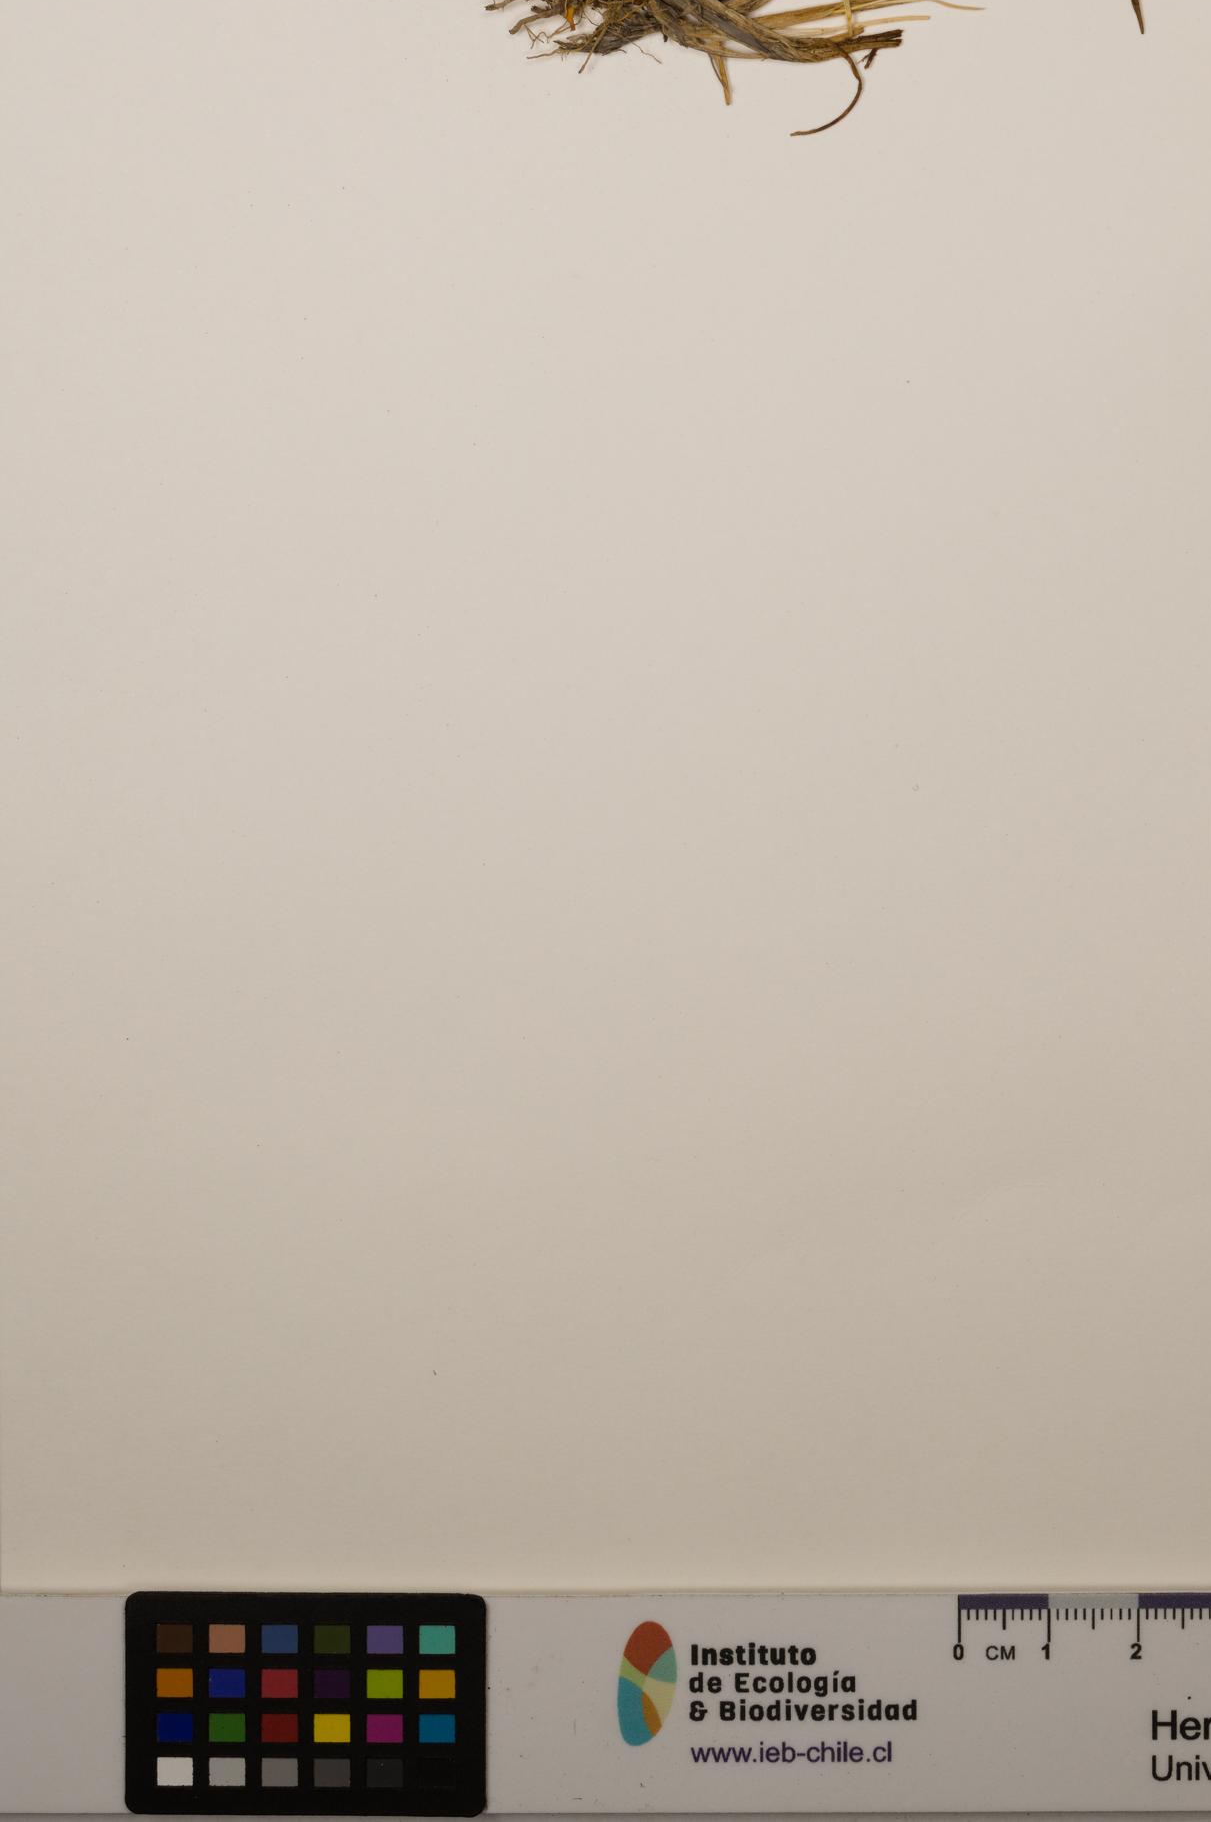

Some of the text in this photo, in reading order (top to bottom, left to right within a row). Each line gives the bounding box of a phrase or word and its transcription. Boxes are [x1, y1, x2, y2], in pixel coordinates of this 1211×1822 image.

[691, 1642, 817, 1666] Instituto
[952, 1643, 964, 1661] 0
[985, 1645, 1016, 1661] CM
[1041, 1643, 1051, 1660] 1
[1130, 1643, 1143, 1660] 2
[689, 1670, 857, 1697] de Ecología
[689, 1699, 918, 1722] & Biodiversidad
[690, 1741, 893, 1764] www.ieb-chile.cl
